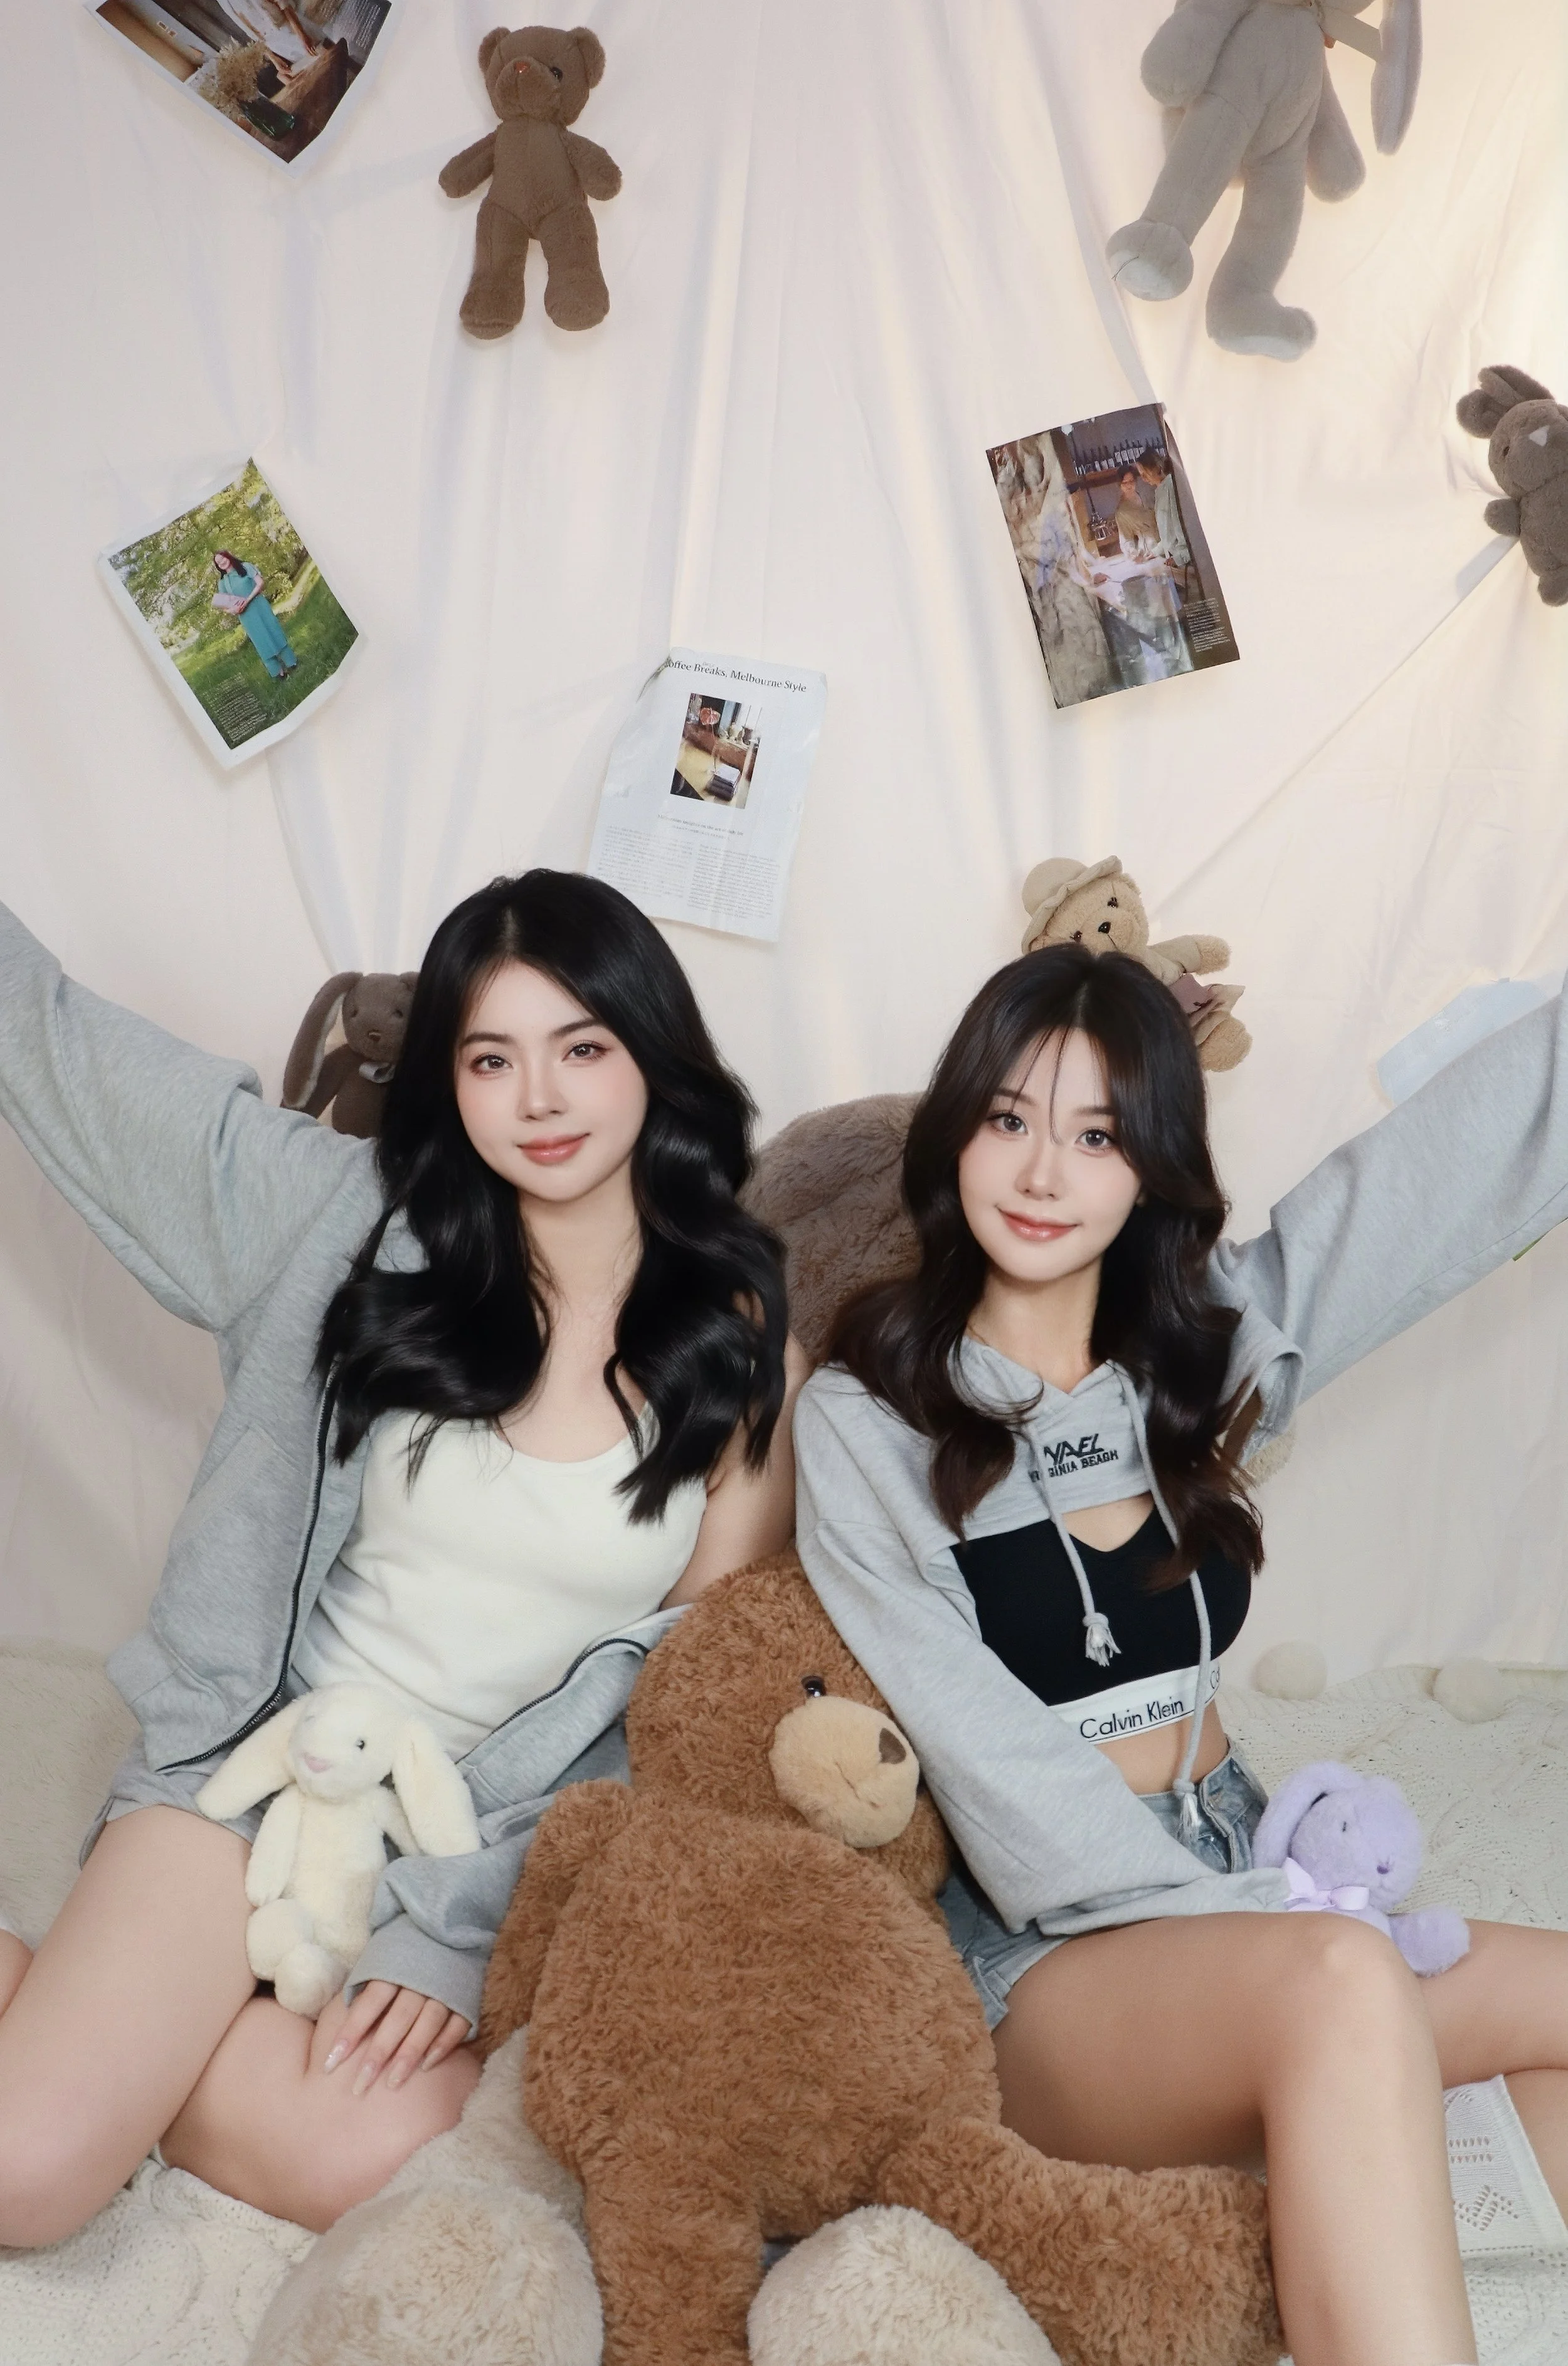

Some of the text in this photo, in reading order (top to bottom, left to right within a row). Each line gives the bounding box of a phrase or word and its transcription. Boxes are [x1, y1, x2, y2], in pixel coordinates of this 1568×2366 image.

[694, 663, 728, 678] Breaks,
[731, 670, 782, 688] Melbourne
[783, 680, 807, 692] Style
[1080, 1696, 1184, 1738] Calvin Klein
